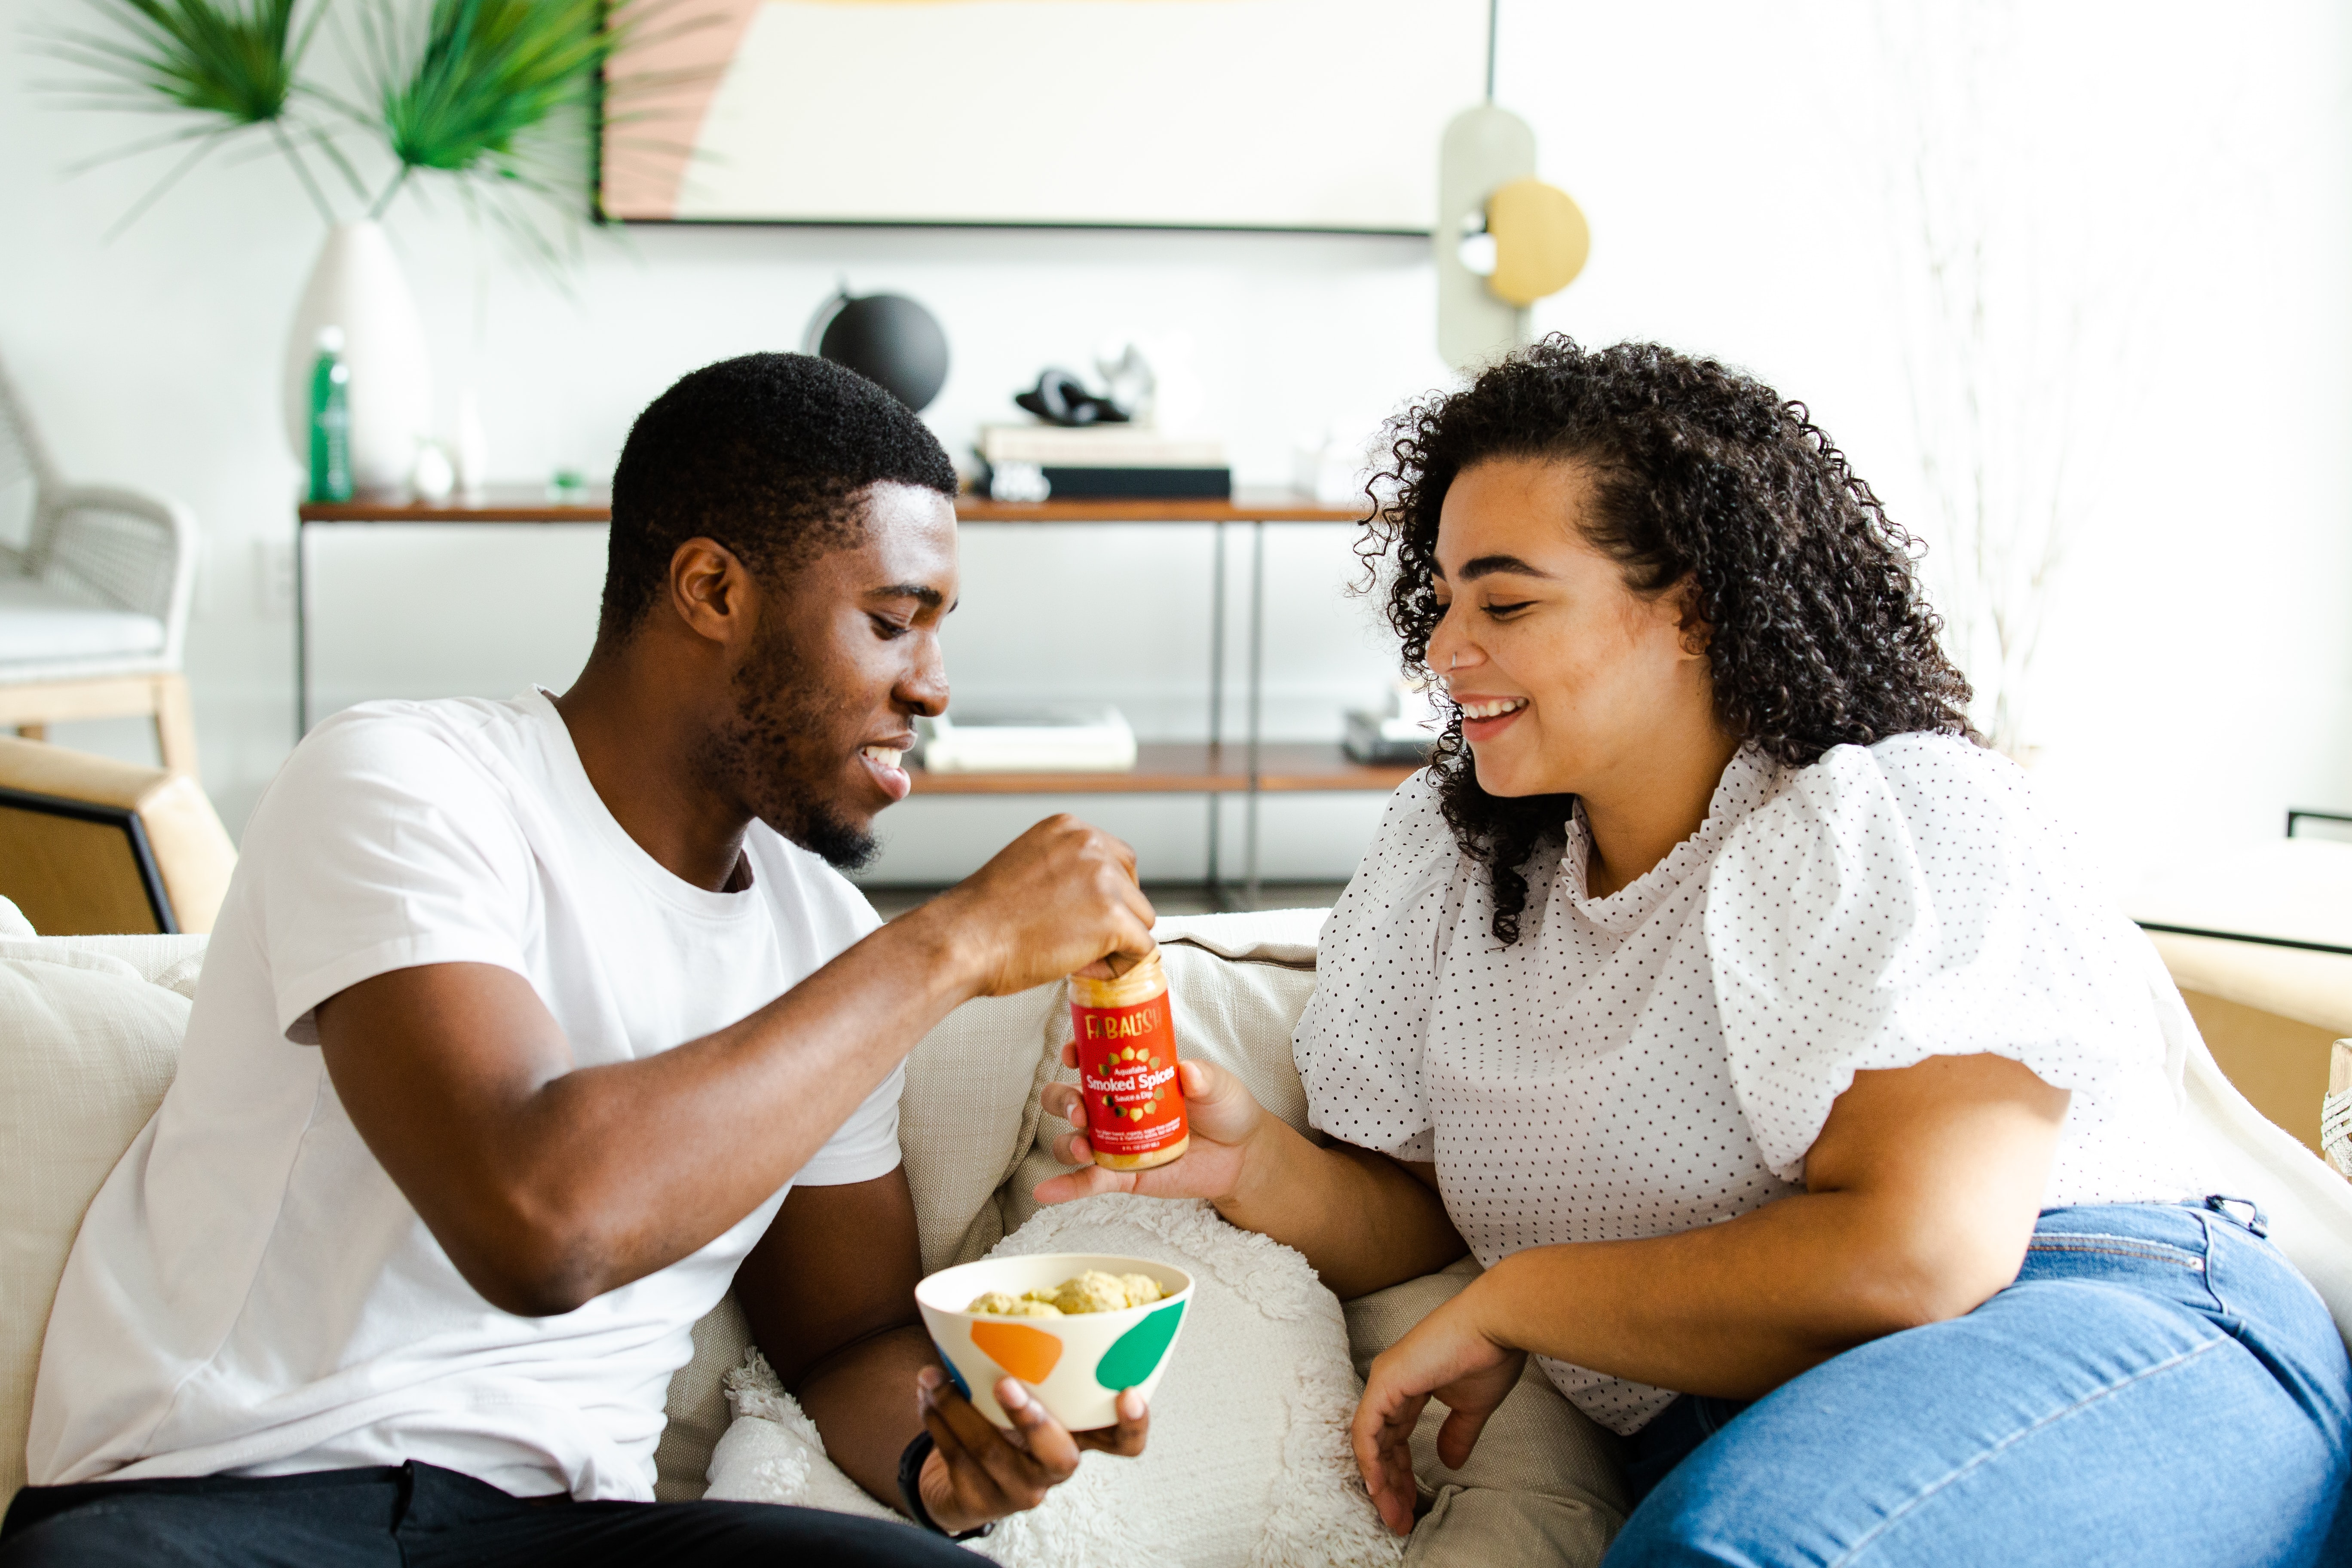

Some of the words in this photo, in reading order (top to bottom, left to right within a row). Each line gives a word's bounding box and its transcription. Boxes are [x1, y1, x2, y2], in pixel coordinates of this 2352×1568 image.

[1087, 1075, 1136, 1092] Smoked
[1138, 1066, 1175, 1090] Spices
[1114, 1093, 1134, 1102] Sauce
[1140, 1091, 1153, 1099] Dip
